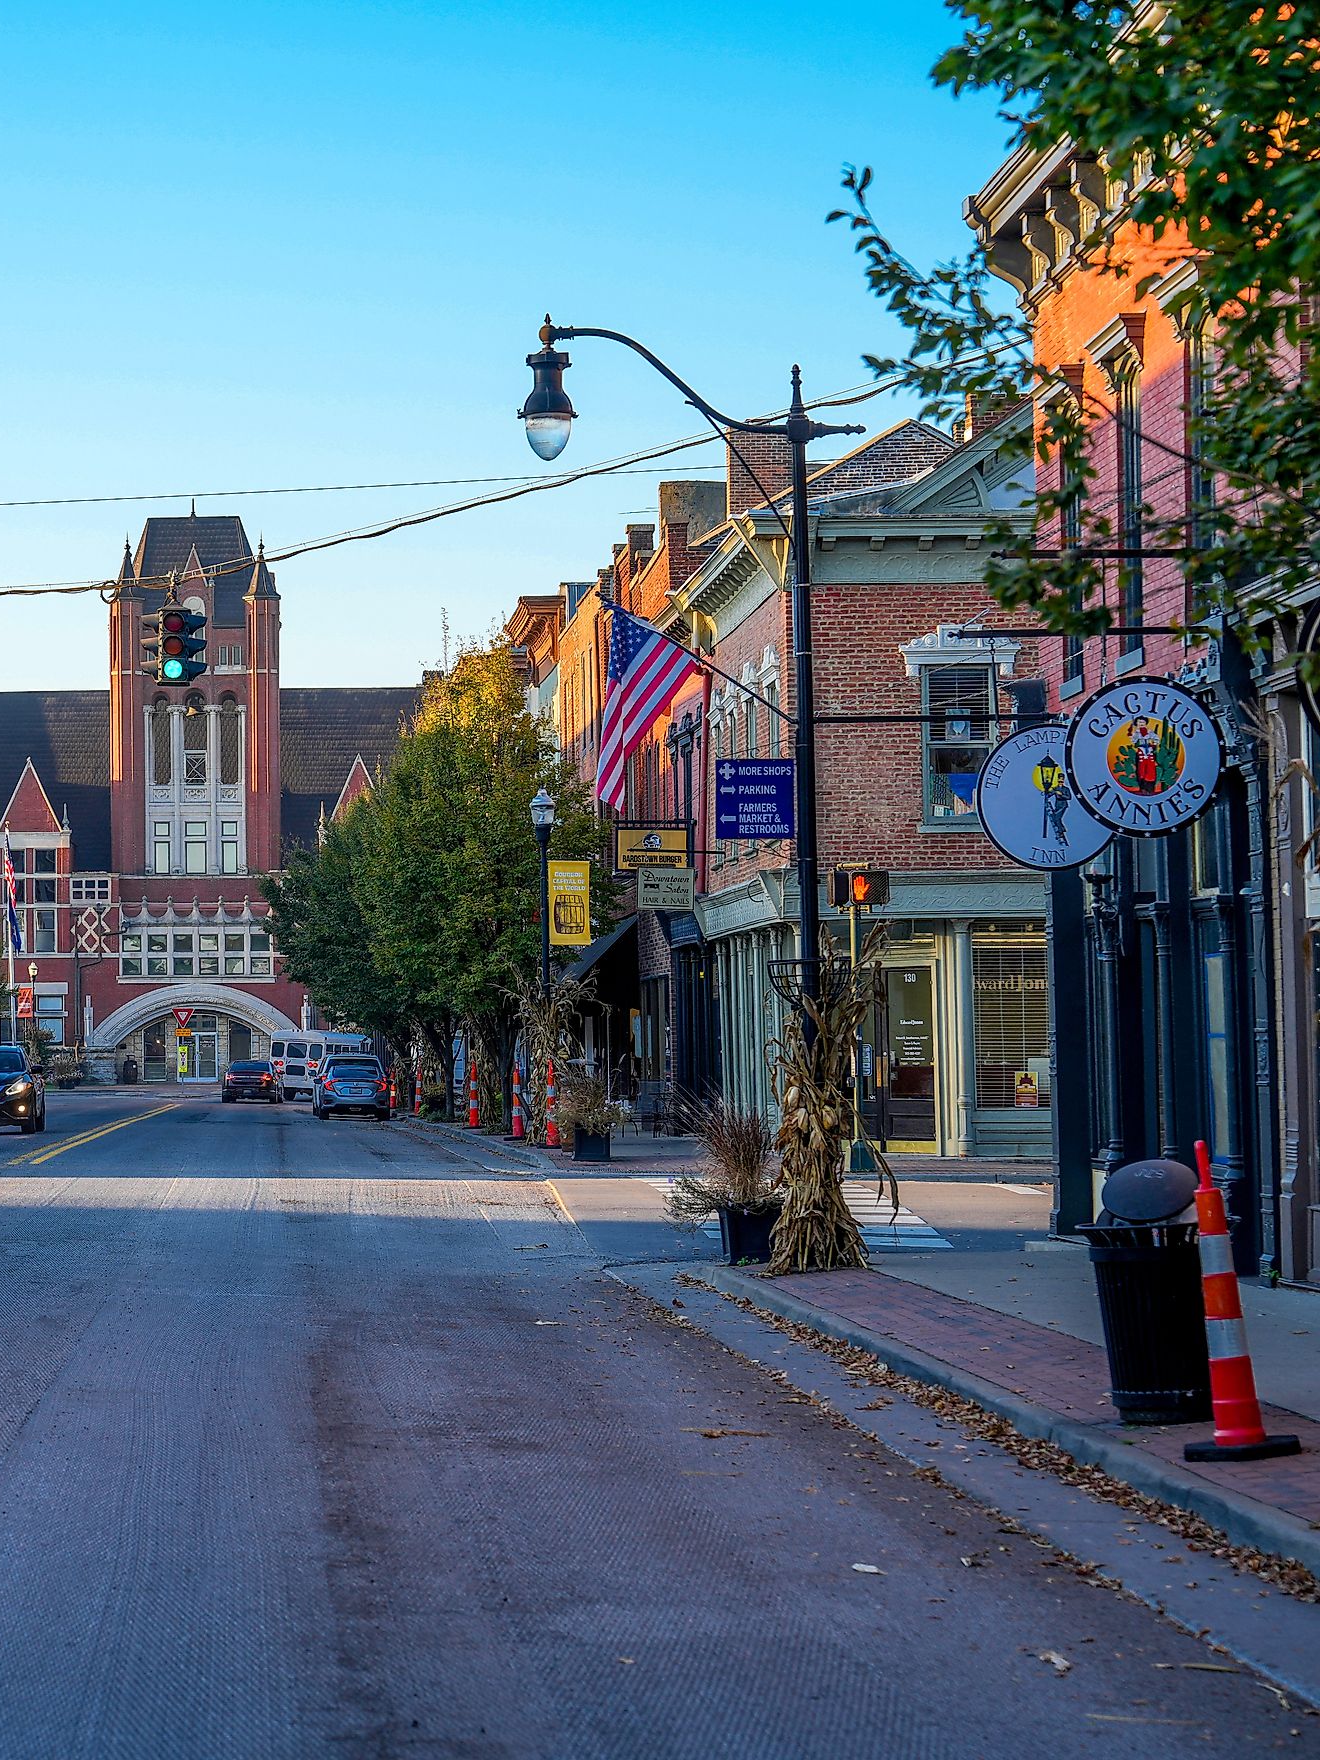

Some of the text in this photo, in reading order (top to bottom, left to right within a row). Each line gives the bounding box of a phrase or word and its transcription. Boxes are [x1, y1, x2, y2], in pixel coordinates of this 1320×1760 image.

[1088, 690, 1204, 740] CACTUS
[738, 766, 792, 776] MORE SHOPS
[985, 754, 1010, 789] THE
[738, 785, 777, 795] PARKING
[1087, 777, 1205, 826] ANNIE'S
[738, 803, 777, 812] FARMERS
[739, 813, 781, 823] MARKET &
[739, 824, 790, 834] RESTROOMS
[622, 854, 682, 863] BARDSTOWN BURGER
[1028, 846, 1066, 864] INN
[641, 870, 690, 883] Downtown
[662, 882, 689, 894] Salon
[642, 896, 659, 904] HAIR
[670, 897, 690, 905] NAILS
[903, 973, 917, 983] 130
